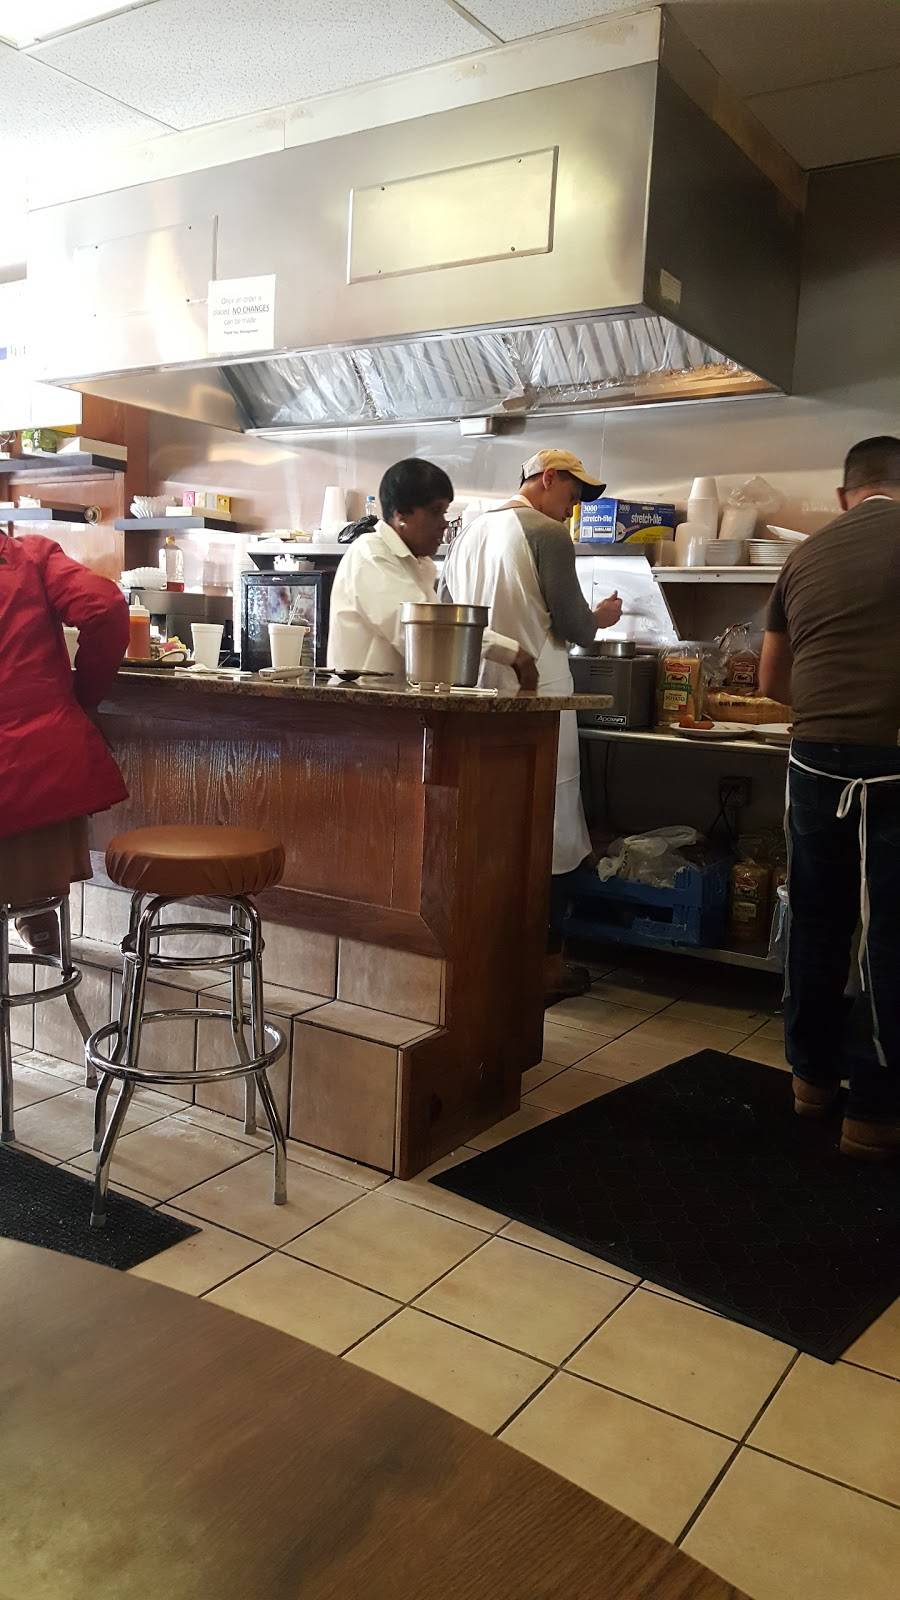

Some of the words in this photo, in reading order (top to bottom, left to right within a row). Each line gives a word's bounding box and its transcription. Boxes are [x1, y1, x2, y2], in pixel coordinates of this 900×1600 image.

[232, 307, 241, 315] NO
[242, 304, 269, 313] CHANGES
[583, 504, 598, 512] 3000
[582, 514, 613, 523] stretch-tite
[631, 512, 662, 525] stretch-tite
